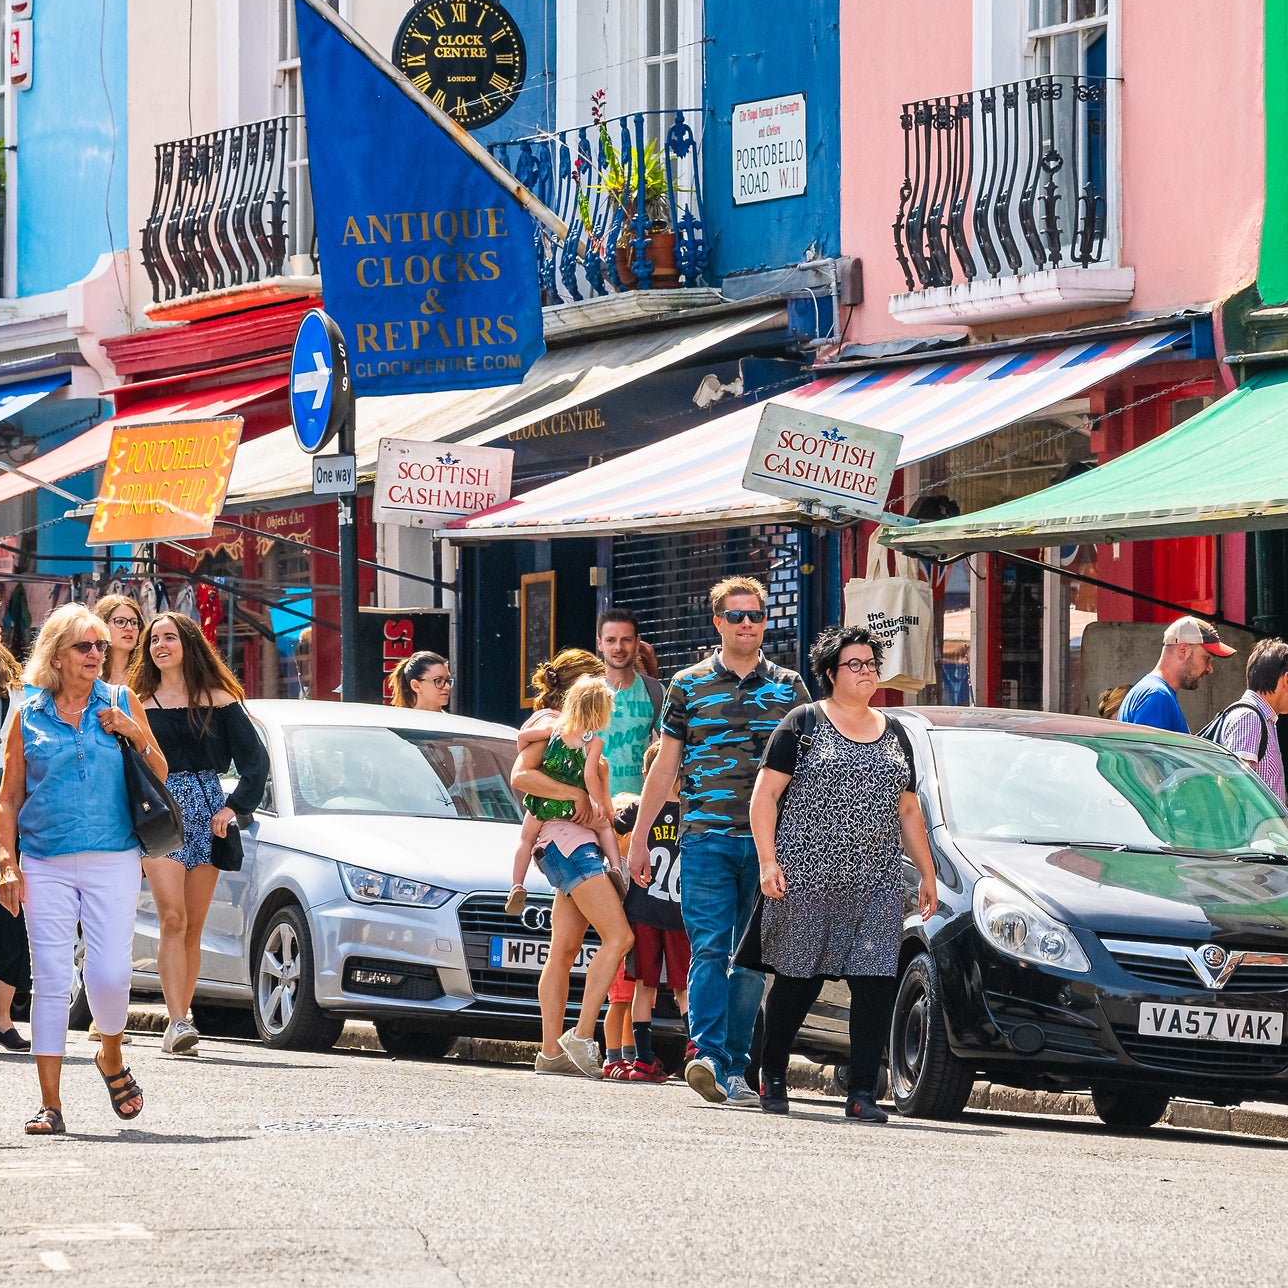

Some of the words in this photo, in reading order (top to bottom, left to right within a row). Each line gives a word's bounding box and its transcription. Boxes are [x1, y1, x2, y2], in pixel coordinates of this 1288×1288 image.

[434, 47, 487, 58] CENTRE
[437, 35, 483, 46] CLOCK
[736, 139, 804, 170] PORTOBELLO
[778, 167, 799, 189] W.11
[341, 208, 508, 246] ANTIQUE
[356, 251, 501, 288] CLOCKS
[420, 288, 446, 315] &
[356, 315, 518, 353] REPAIRS
[355, 354, 522, 378] CLOCKCENTRE.COM
[507, 416, 549, 441] CLOCK
[125, 436, 220, 474] PORTOBELLO
[778, 430, 876, 469] SCOTTISH
[316, 467, 333, 484] One
[335, 468, 351, 486] way
[398, 461, 489, 487] SCOTTISH
[764, 453, 878, 496] CASHMERE
[113, 481, 170, 519] SPRING
[170, 478, 207, 512] CHIP
[388, 485, 497, 511] CASHMERE
[266, 513, 287, 529] Objets
[867, 611, 885, 622] the
[868, 616, 904, 632] Notting
[905, 615, 919, 625] Hill
[653, 825, 677, 841] BEL
[508, 942, 551, 965] WP6
[1152, 1008, 1218, 1035] VA57
[1226, 1013, 1272, 1040] VAK
